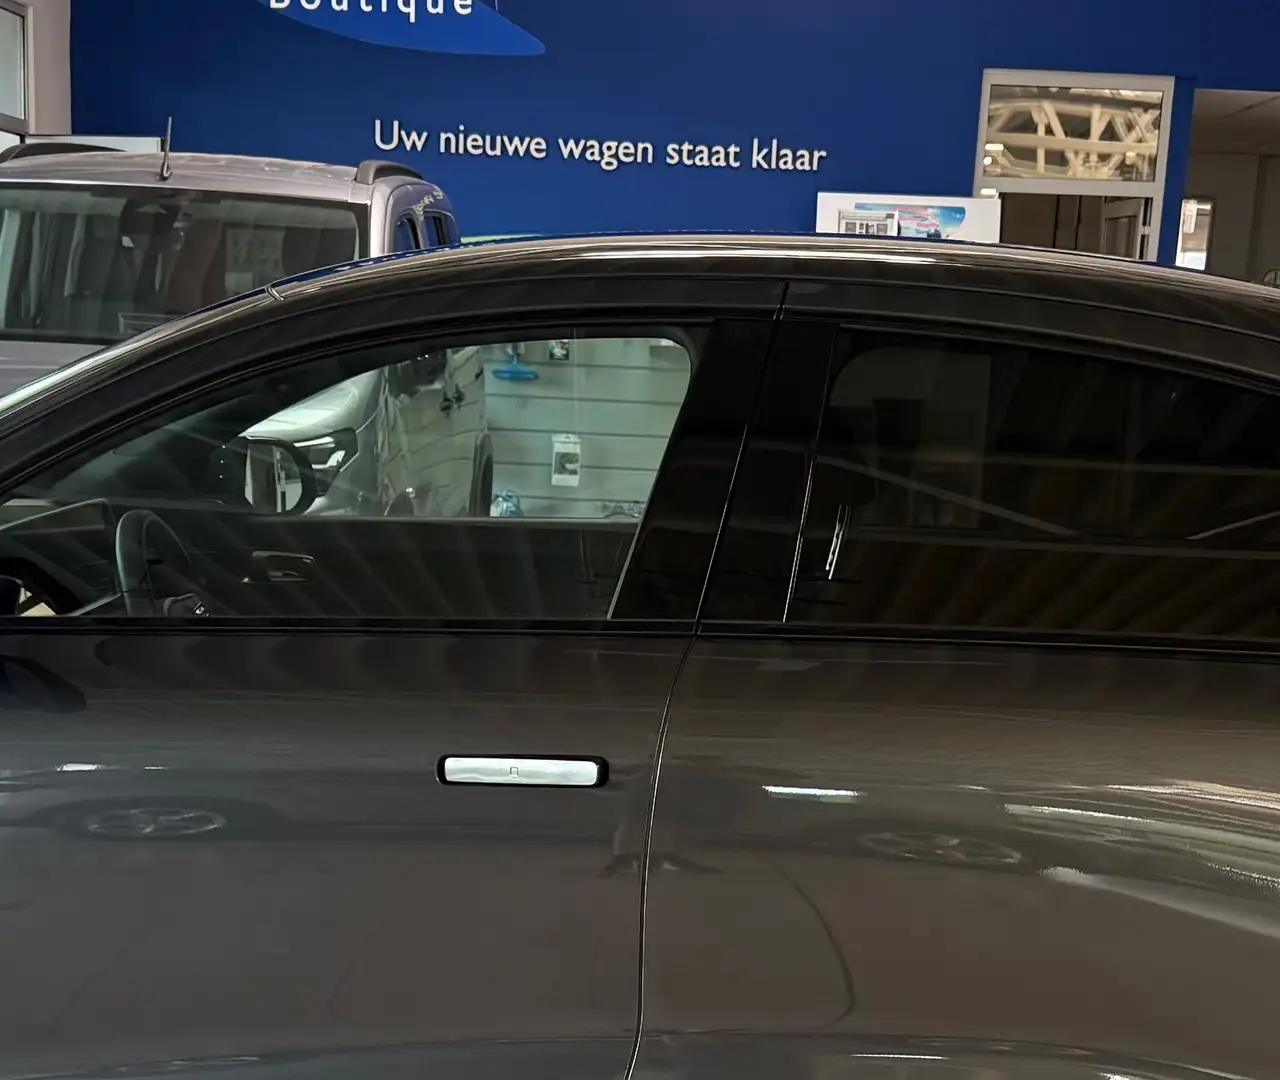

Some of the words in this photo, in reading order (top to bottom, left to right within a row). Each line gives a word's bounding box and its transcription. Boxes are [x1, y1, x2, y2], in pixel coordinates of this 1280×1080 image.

[373, 119, 429, 152] Uw
[439, 124, 547, 159] nieuwe
[557, 136, 653, 171] wagen
[665, 137, 741, 168] staat
[751, 138, 828, 171] klaar
